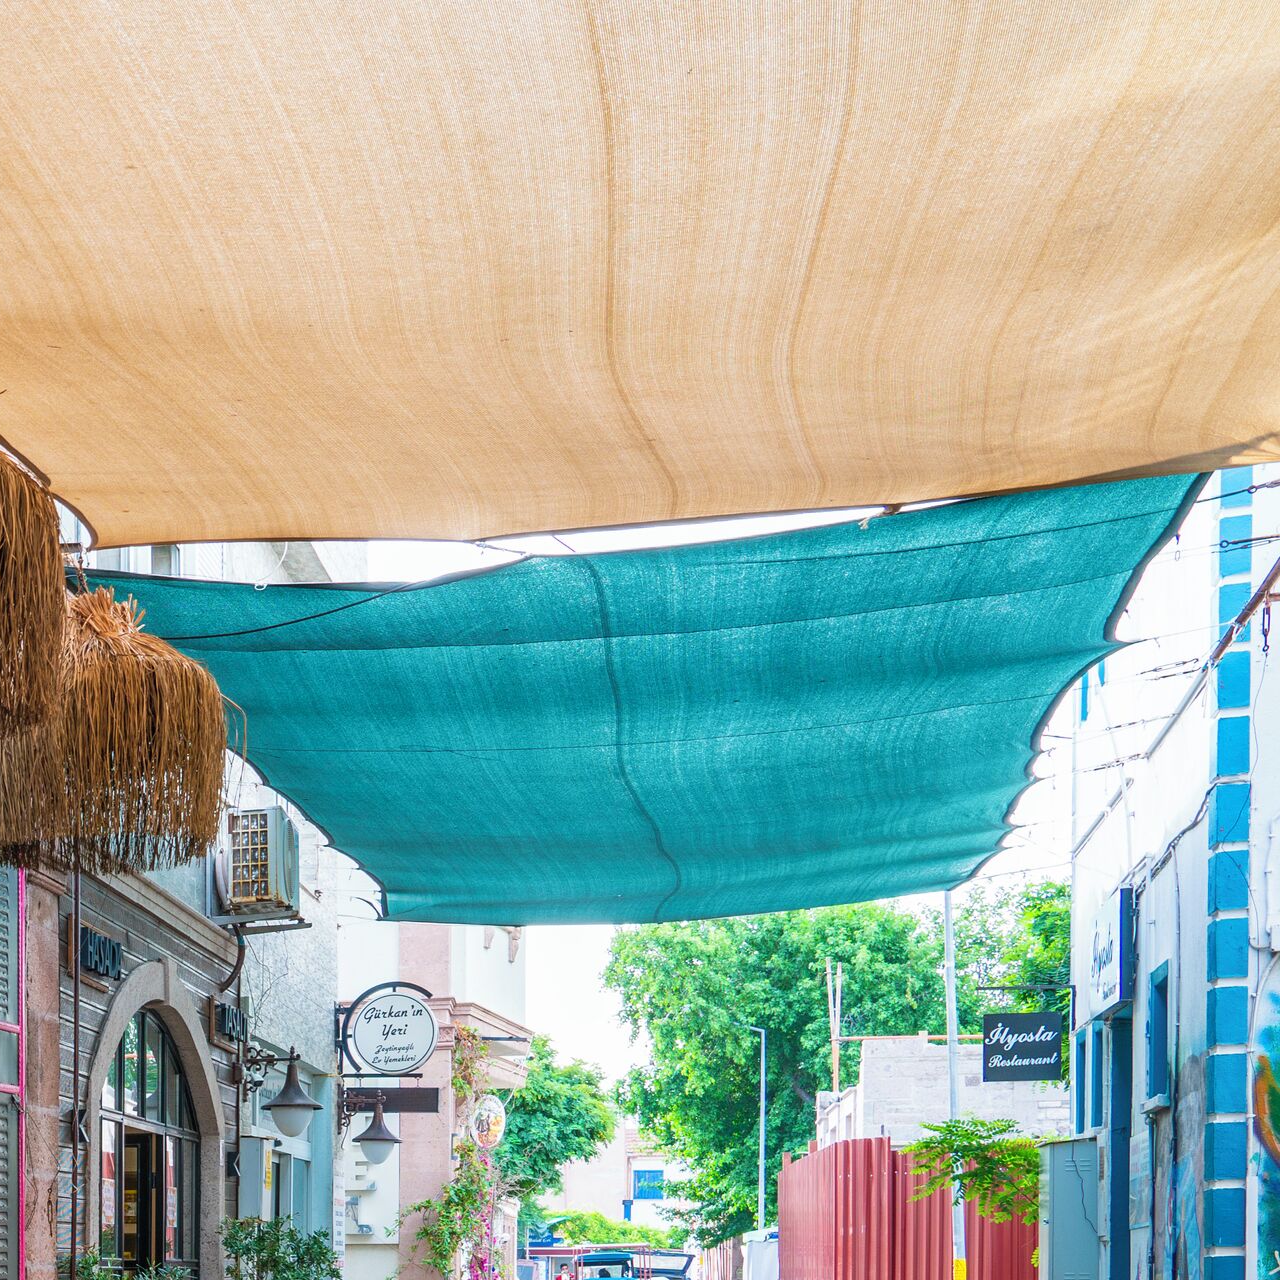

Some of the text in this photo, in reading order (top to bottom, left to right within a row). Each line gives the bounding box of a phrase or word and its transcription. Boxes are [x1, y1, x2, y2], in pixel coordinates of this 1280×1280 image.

[382, 1024, 408, 1041] Yeri
[985, 1022, 1058, 1051] İlyosta
[988, 1052, 1058, 1068] Restaurant
